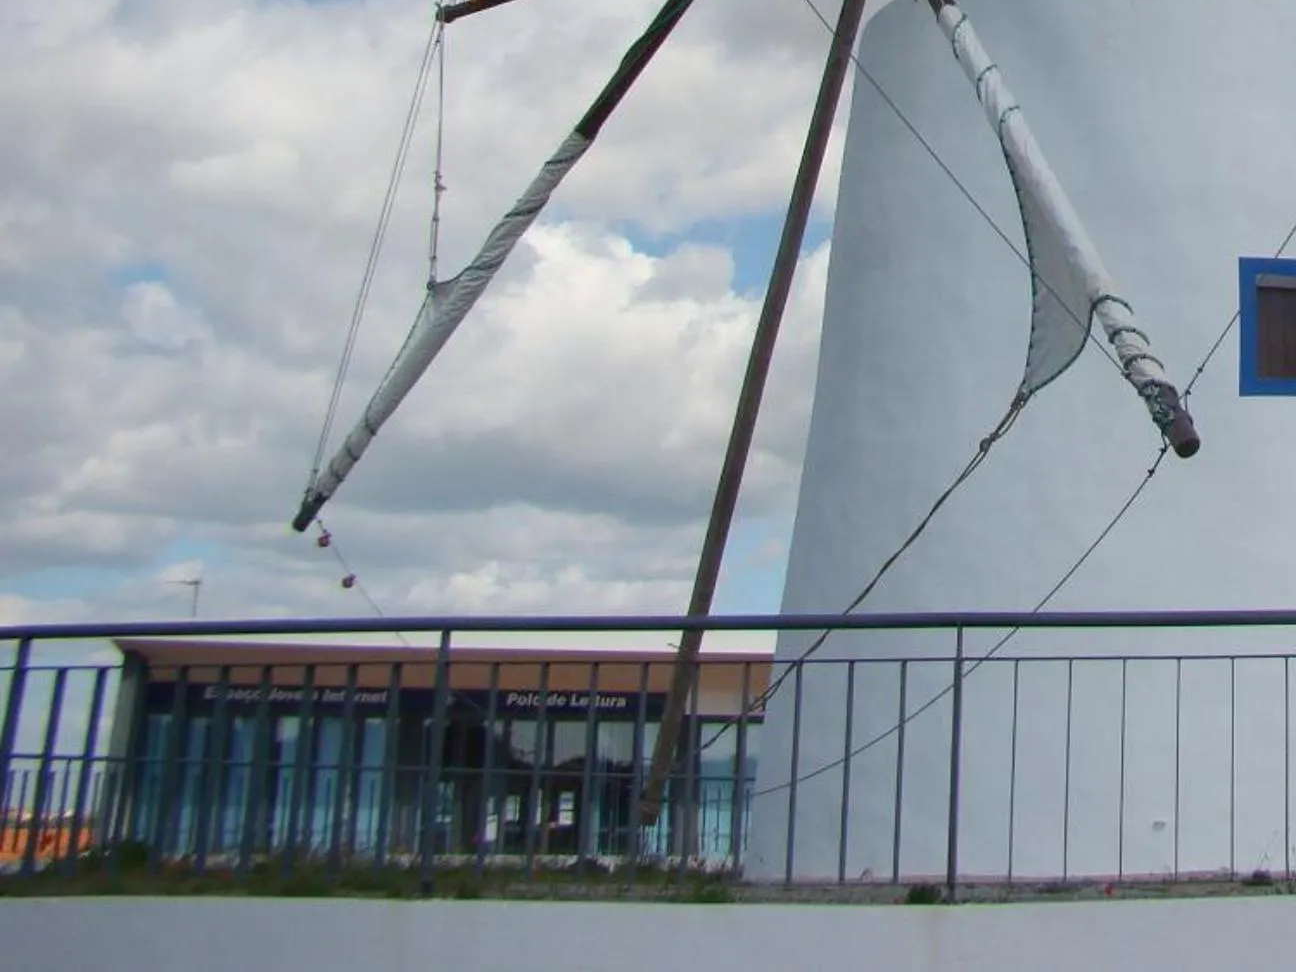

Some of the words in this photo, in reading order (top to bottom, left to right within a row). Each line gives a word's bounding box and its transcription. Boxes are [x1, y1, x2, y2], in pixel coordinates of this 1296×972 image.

[204, 686, 263, 704] Epaço
[322, 688, 388, 703] Intrnet
[546, 692, 567, 707] de
[570, 693, 627, 708] Letura
